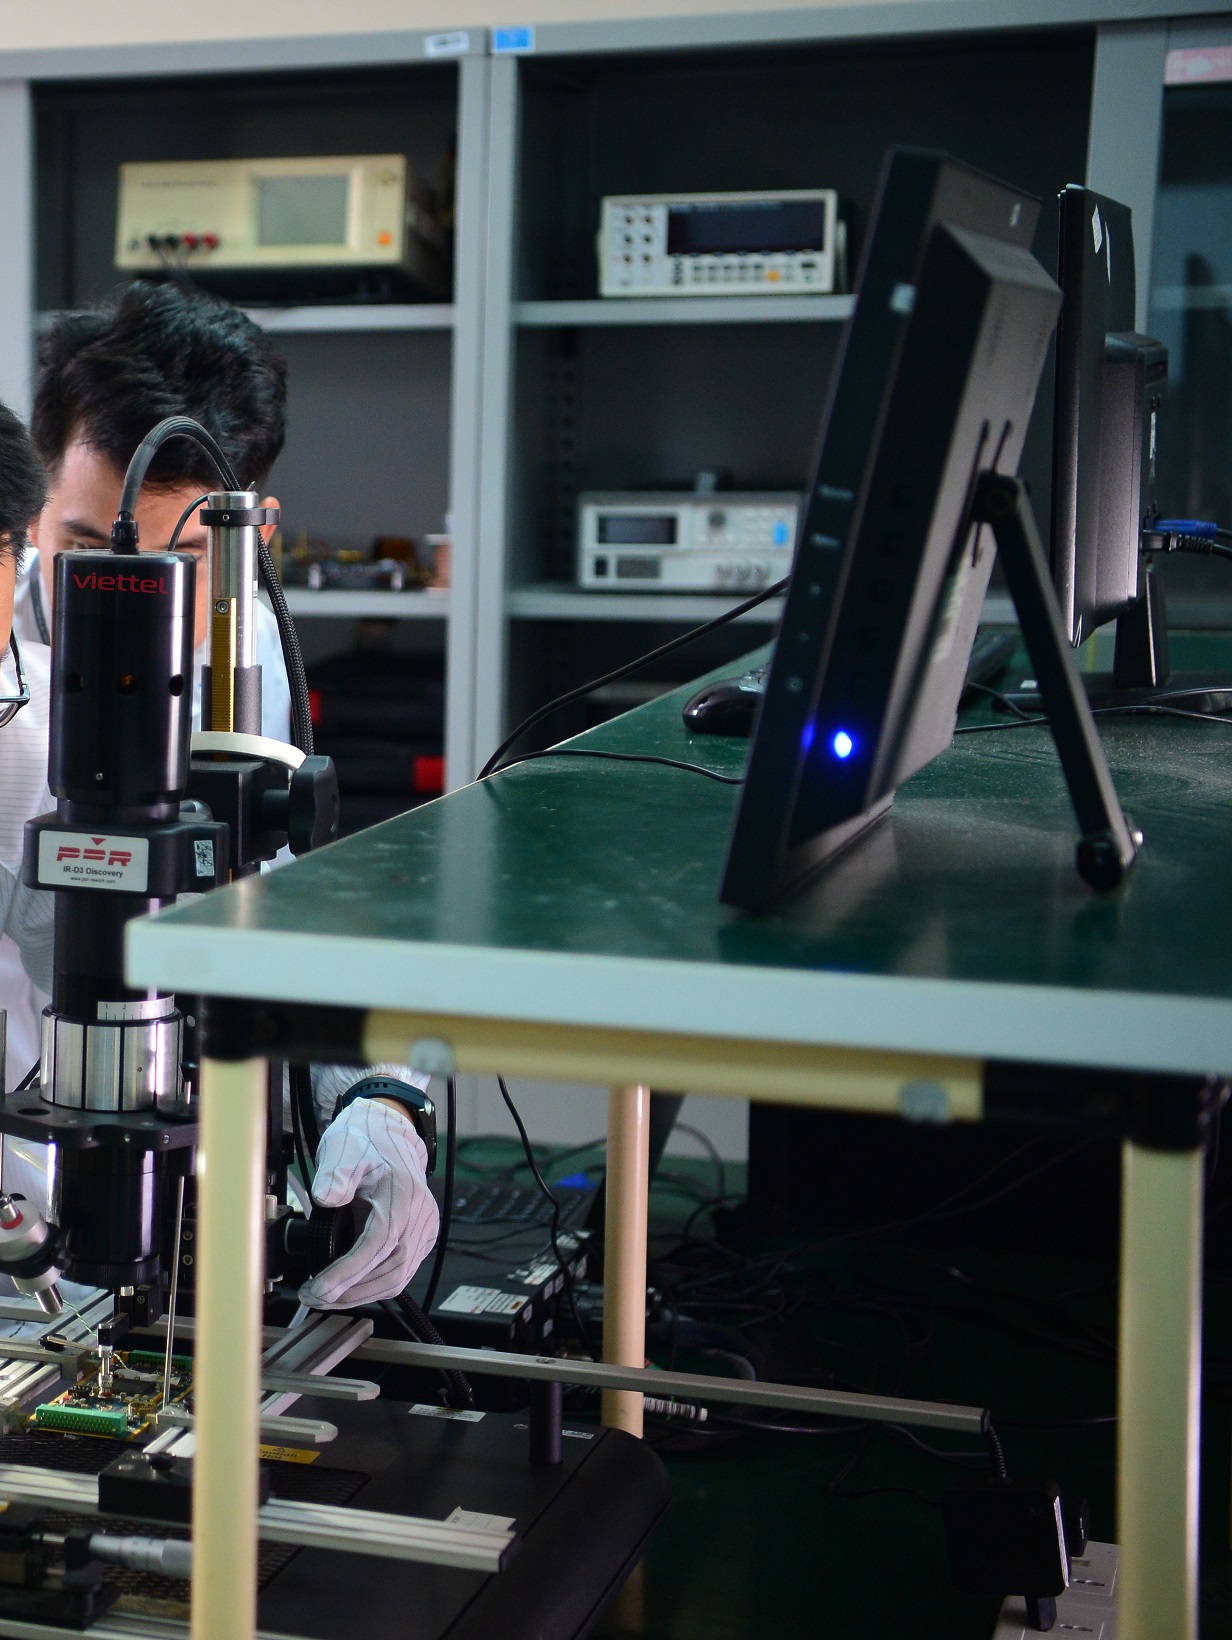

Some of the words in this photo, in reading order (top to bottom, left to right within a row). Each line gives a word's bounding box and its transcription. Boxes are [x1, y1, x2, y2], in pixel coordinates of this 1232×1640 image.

[73, 572, 168, 594] viettel
[56, 846, 132, 867] PDR
[63, 865, 84, 874] IR-D3
[85, 867, 124, 879] Discovery
